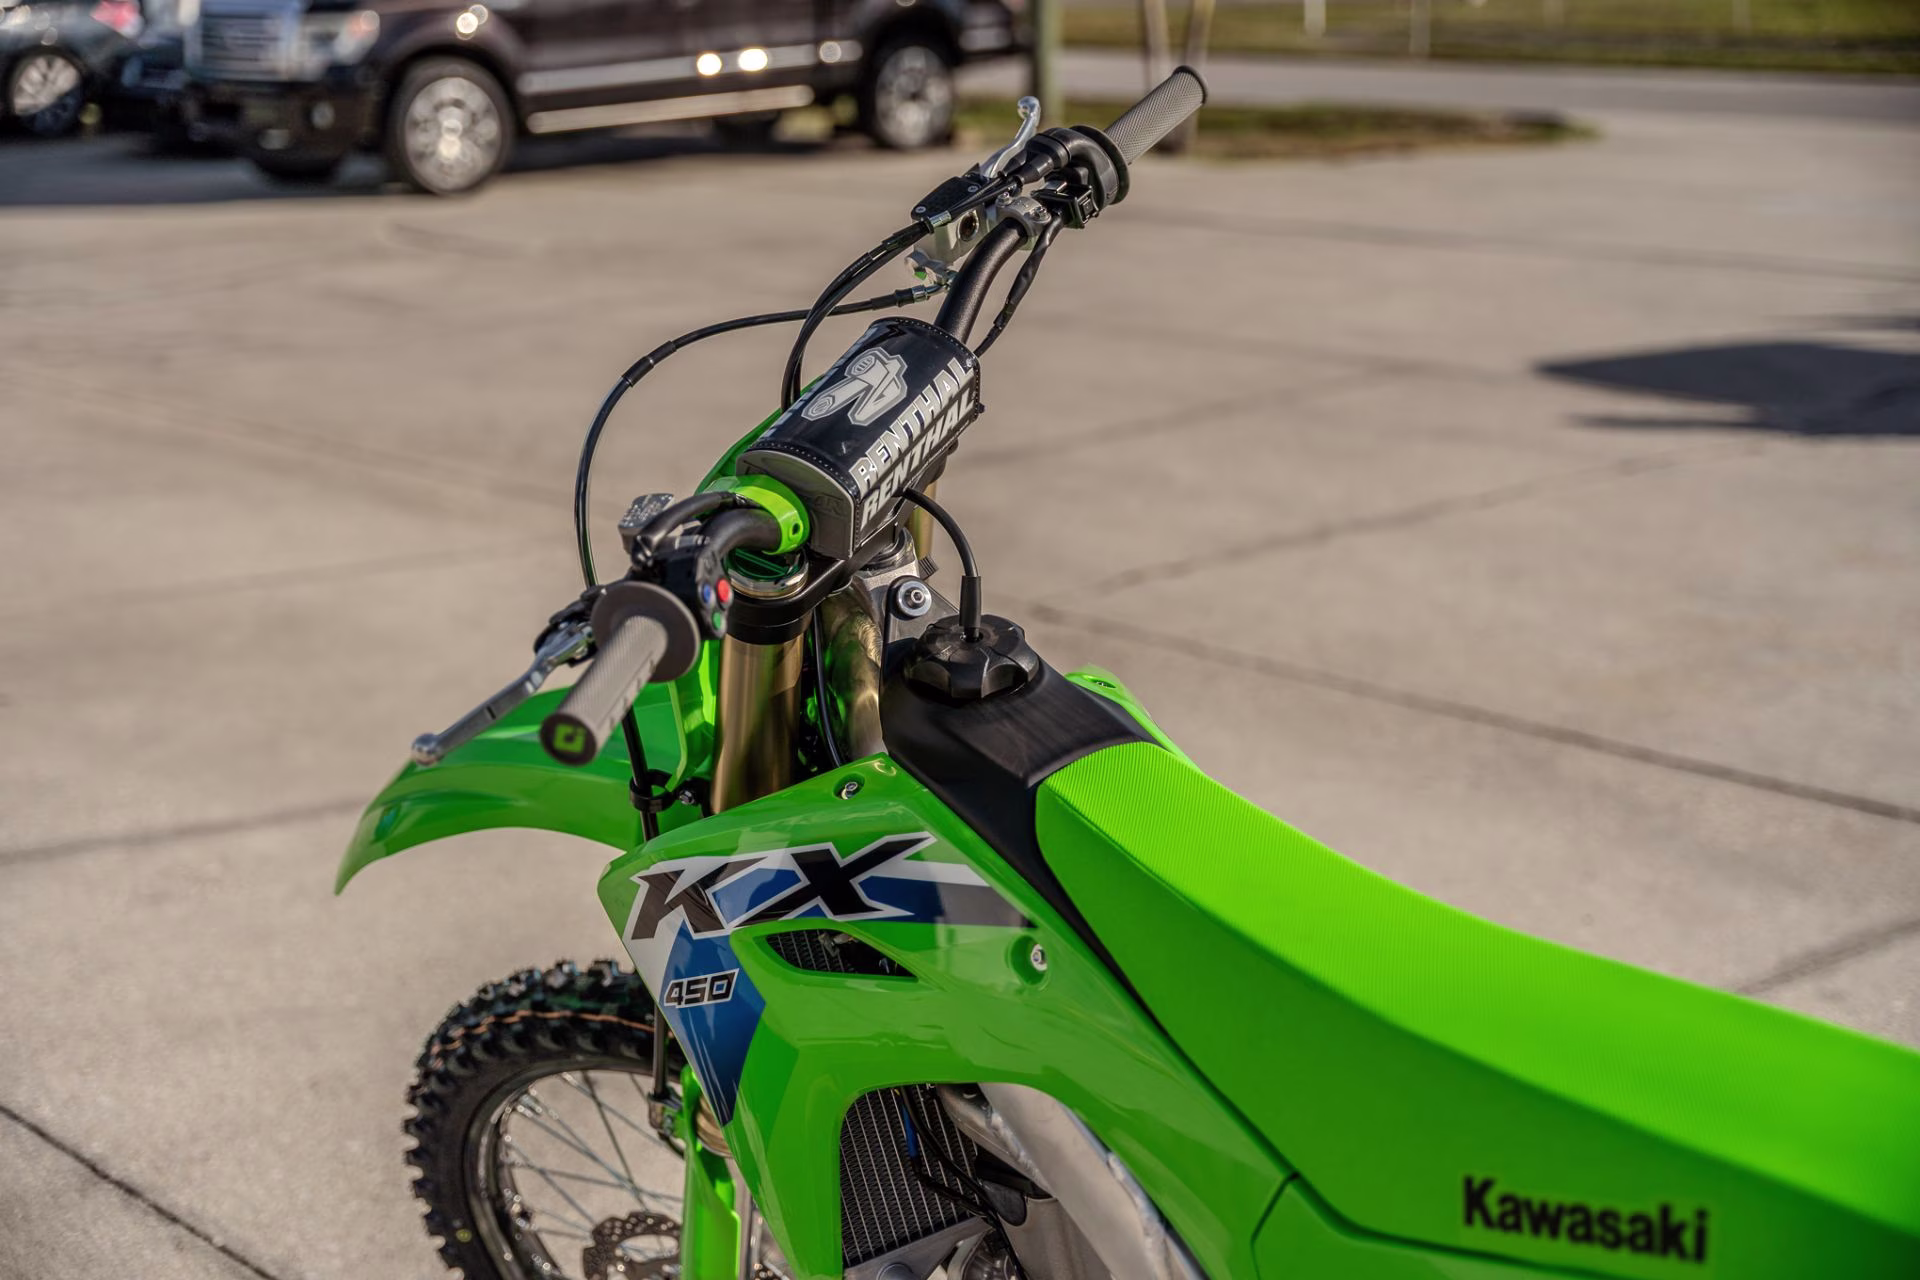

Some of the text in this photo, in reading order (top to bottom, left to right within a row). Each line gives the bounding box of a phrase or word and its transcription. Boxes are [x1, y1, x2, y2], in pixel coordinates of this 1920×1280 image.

[849, 357, 974, 498] RENTHAL
[860, 387, 976, 530] RENTHAL
[625, 832, 936, 940] KX
[664, 968, 739, 1008] 450
[1463, 1175, 1709, 1263] Kawasaki
